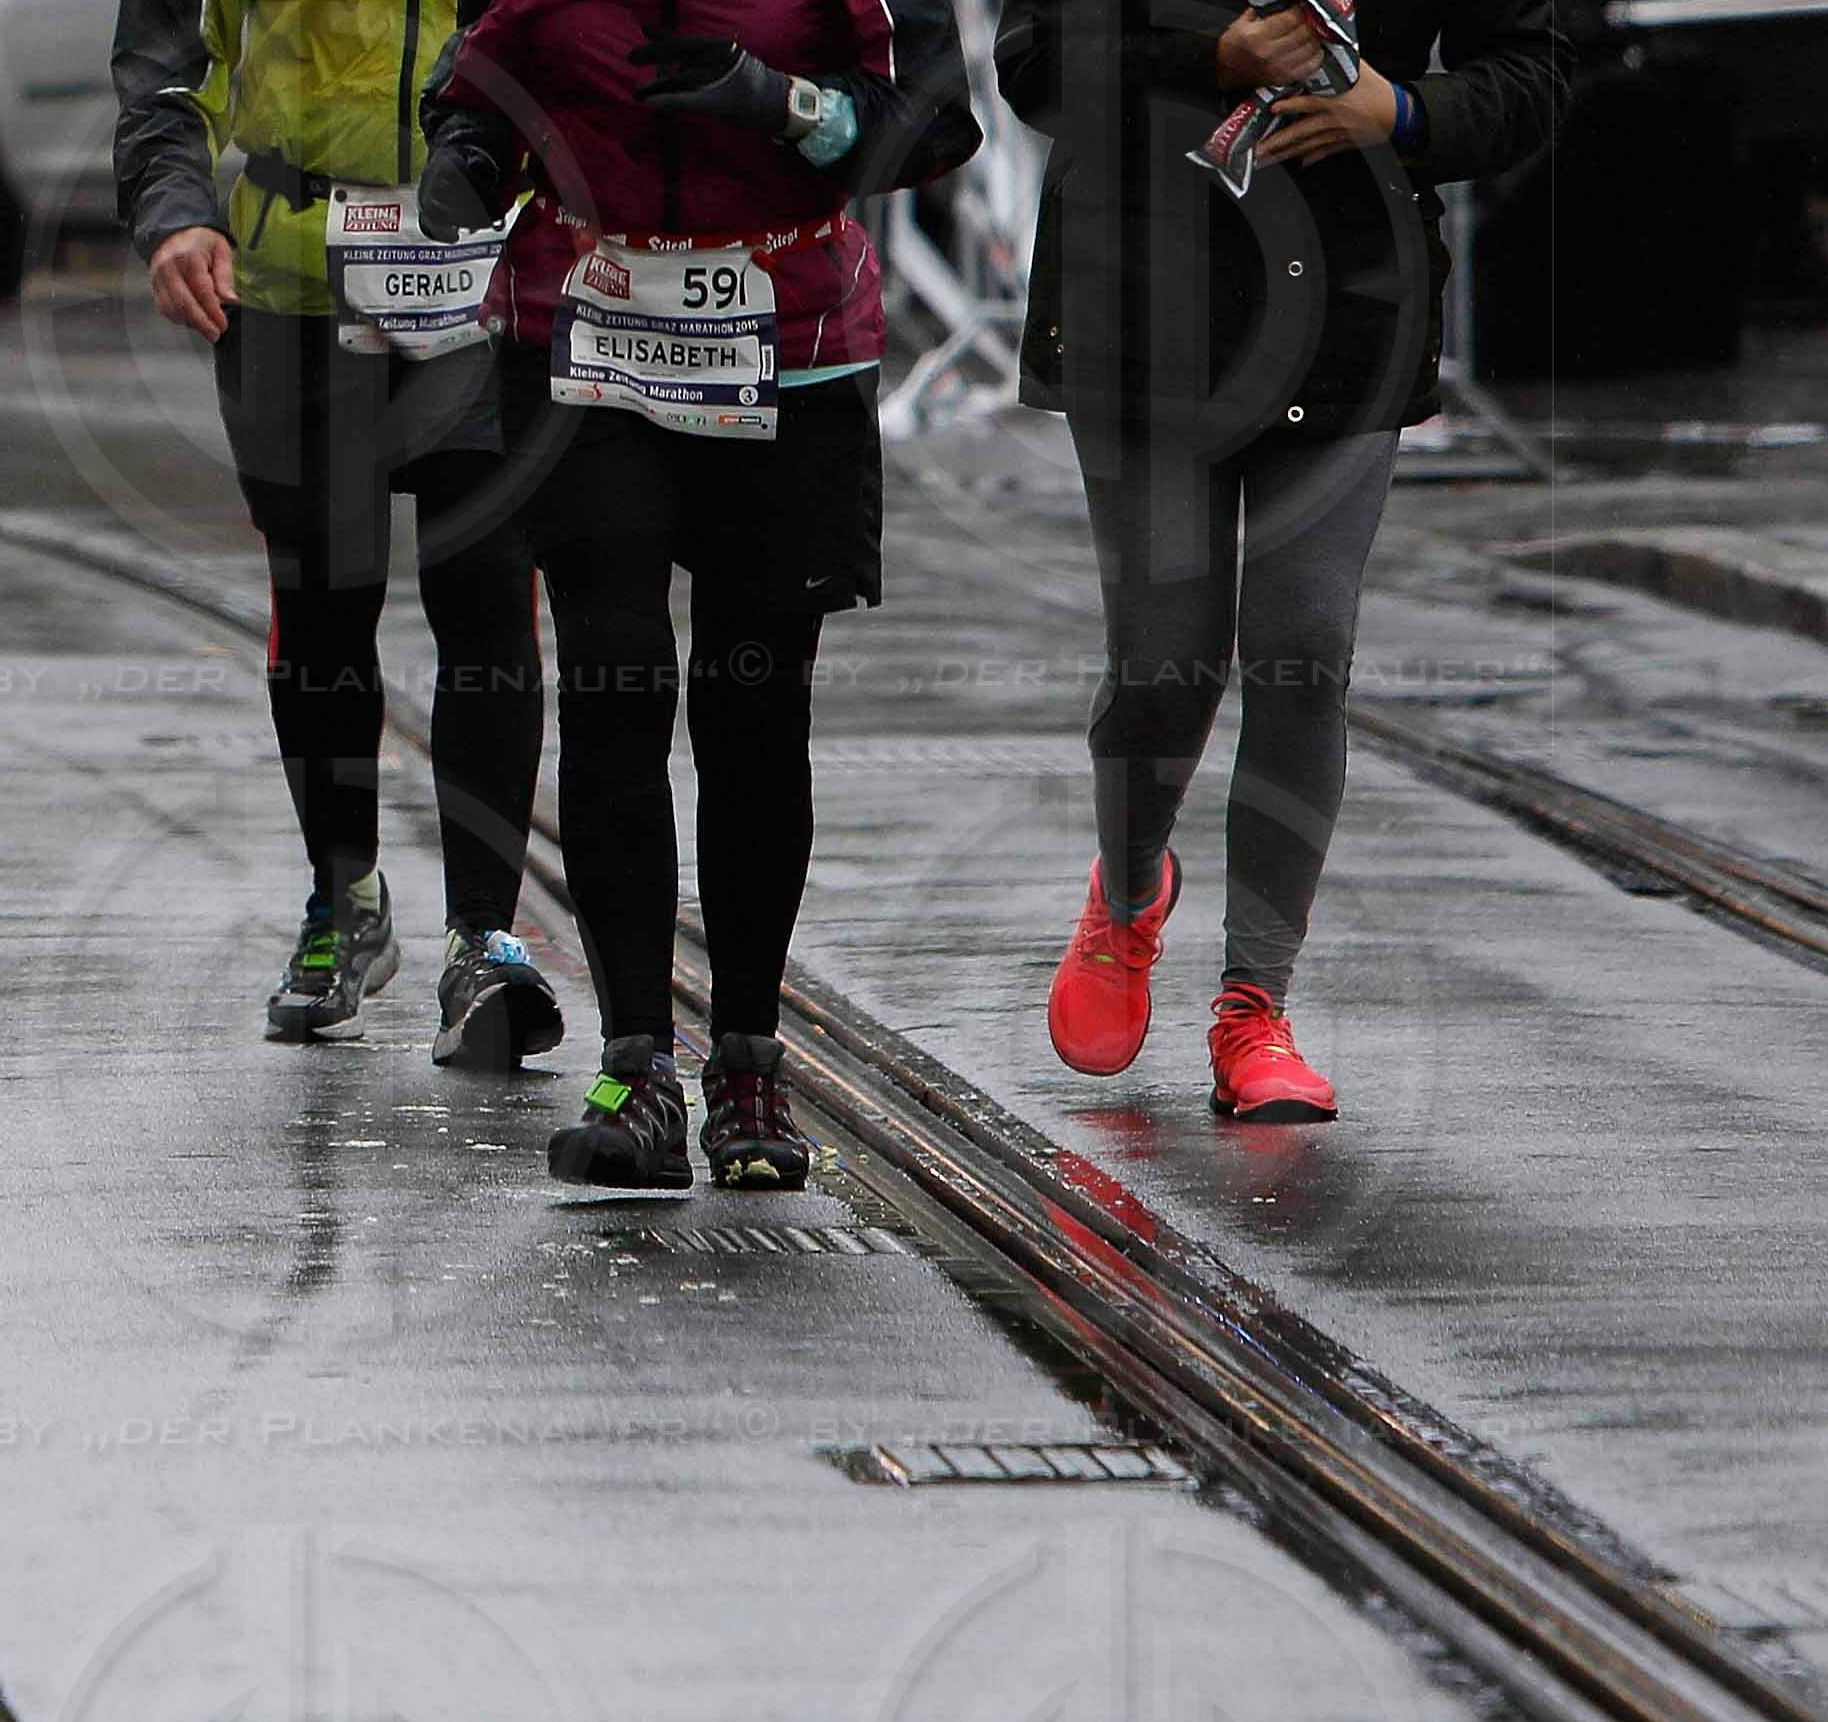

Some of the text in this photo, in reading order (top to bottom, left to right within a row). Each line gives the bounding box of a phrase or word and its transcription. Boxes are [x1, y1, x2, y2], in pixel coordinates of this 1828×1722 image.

[347, 207, 398, 221] KLEINE
[345, 220, 398, 231] ZEITUNG
[344, 248, 375, 261] KLEINE
[377, 248, 416, 262] ZEITUNG
[418, 247, 441, 260] GRAZ
[385, 269, 473, 296] GERALD
[682, 267, 747, 310] 591
[680, 322, 734, 335] MARATHON
[735, 319, 759, 334] 2015
[596, 336, 737, 367] ELISABETH
[569, 365, 606, 380] Kleine
[649, 384, 703, 402] Marathon
